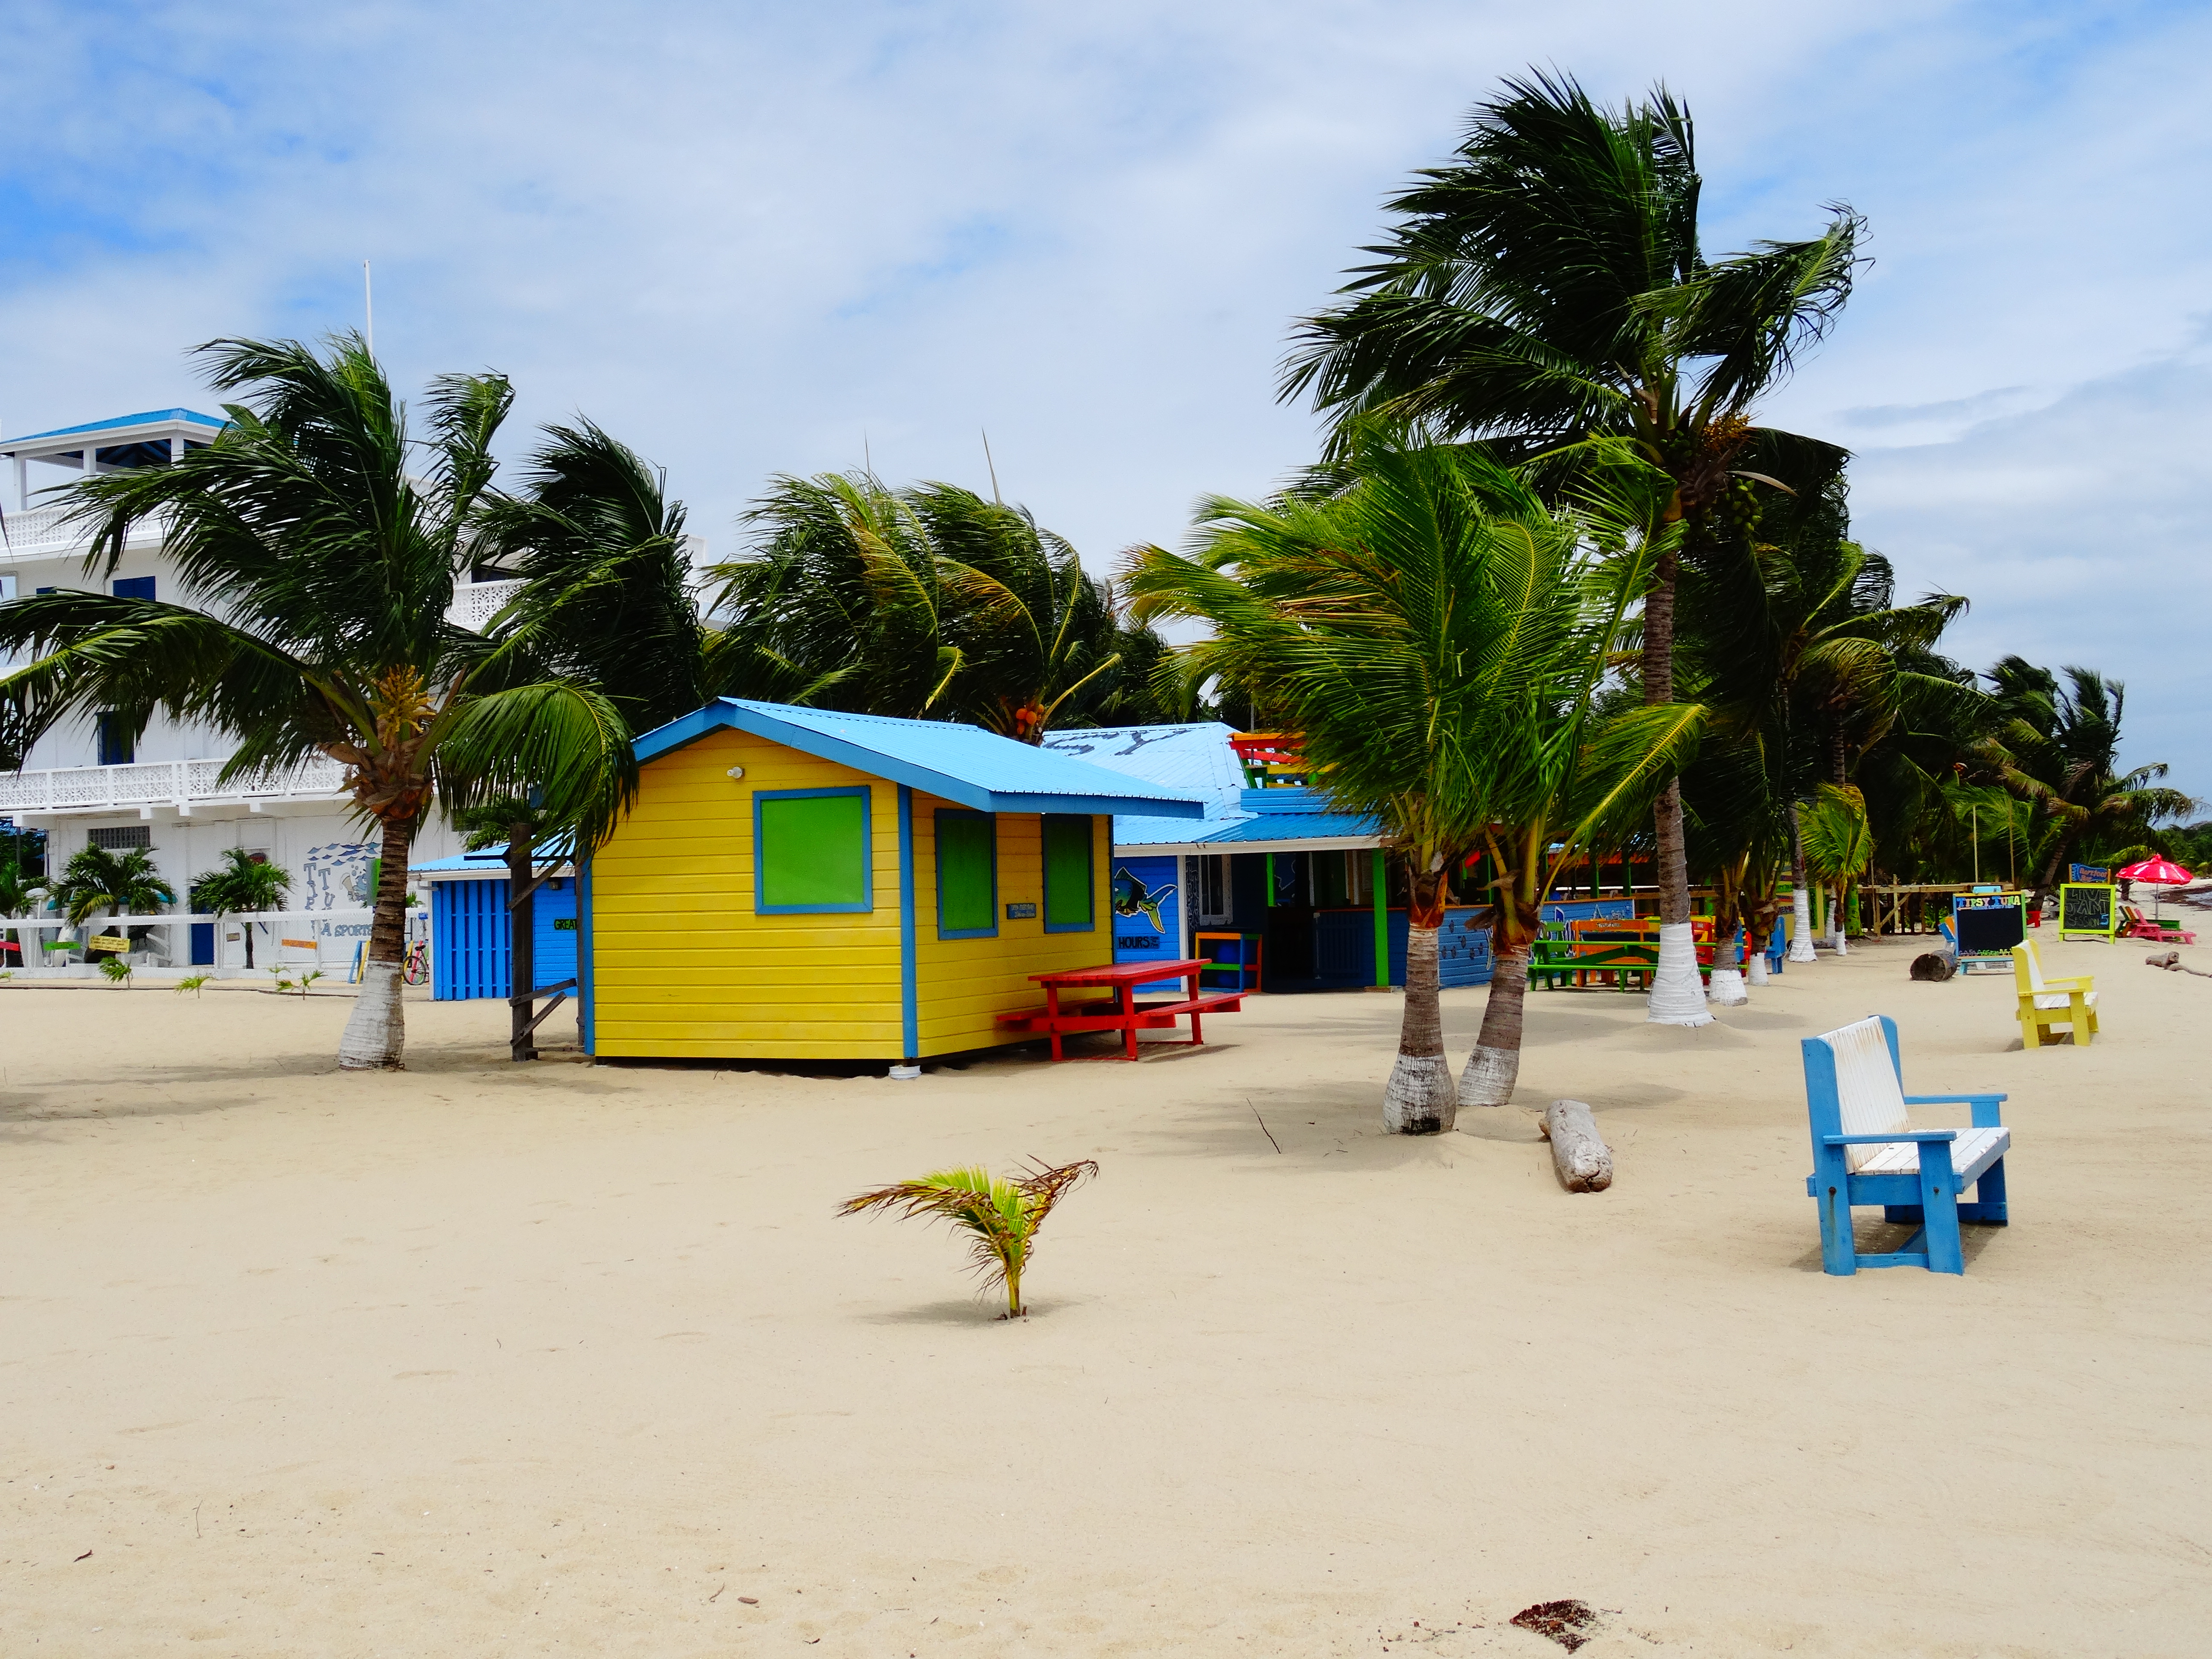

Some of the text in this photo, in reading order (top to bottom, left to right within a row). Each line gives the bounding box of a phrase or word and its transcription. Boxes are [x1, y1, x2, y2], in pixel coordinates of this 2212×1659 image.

[1956, 896, 2021, 907] TIPSY TUNA
[2066, 889, 2110, 902] LIVE
[1119, 936, 1150, 948] HOURS
